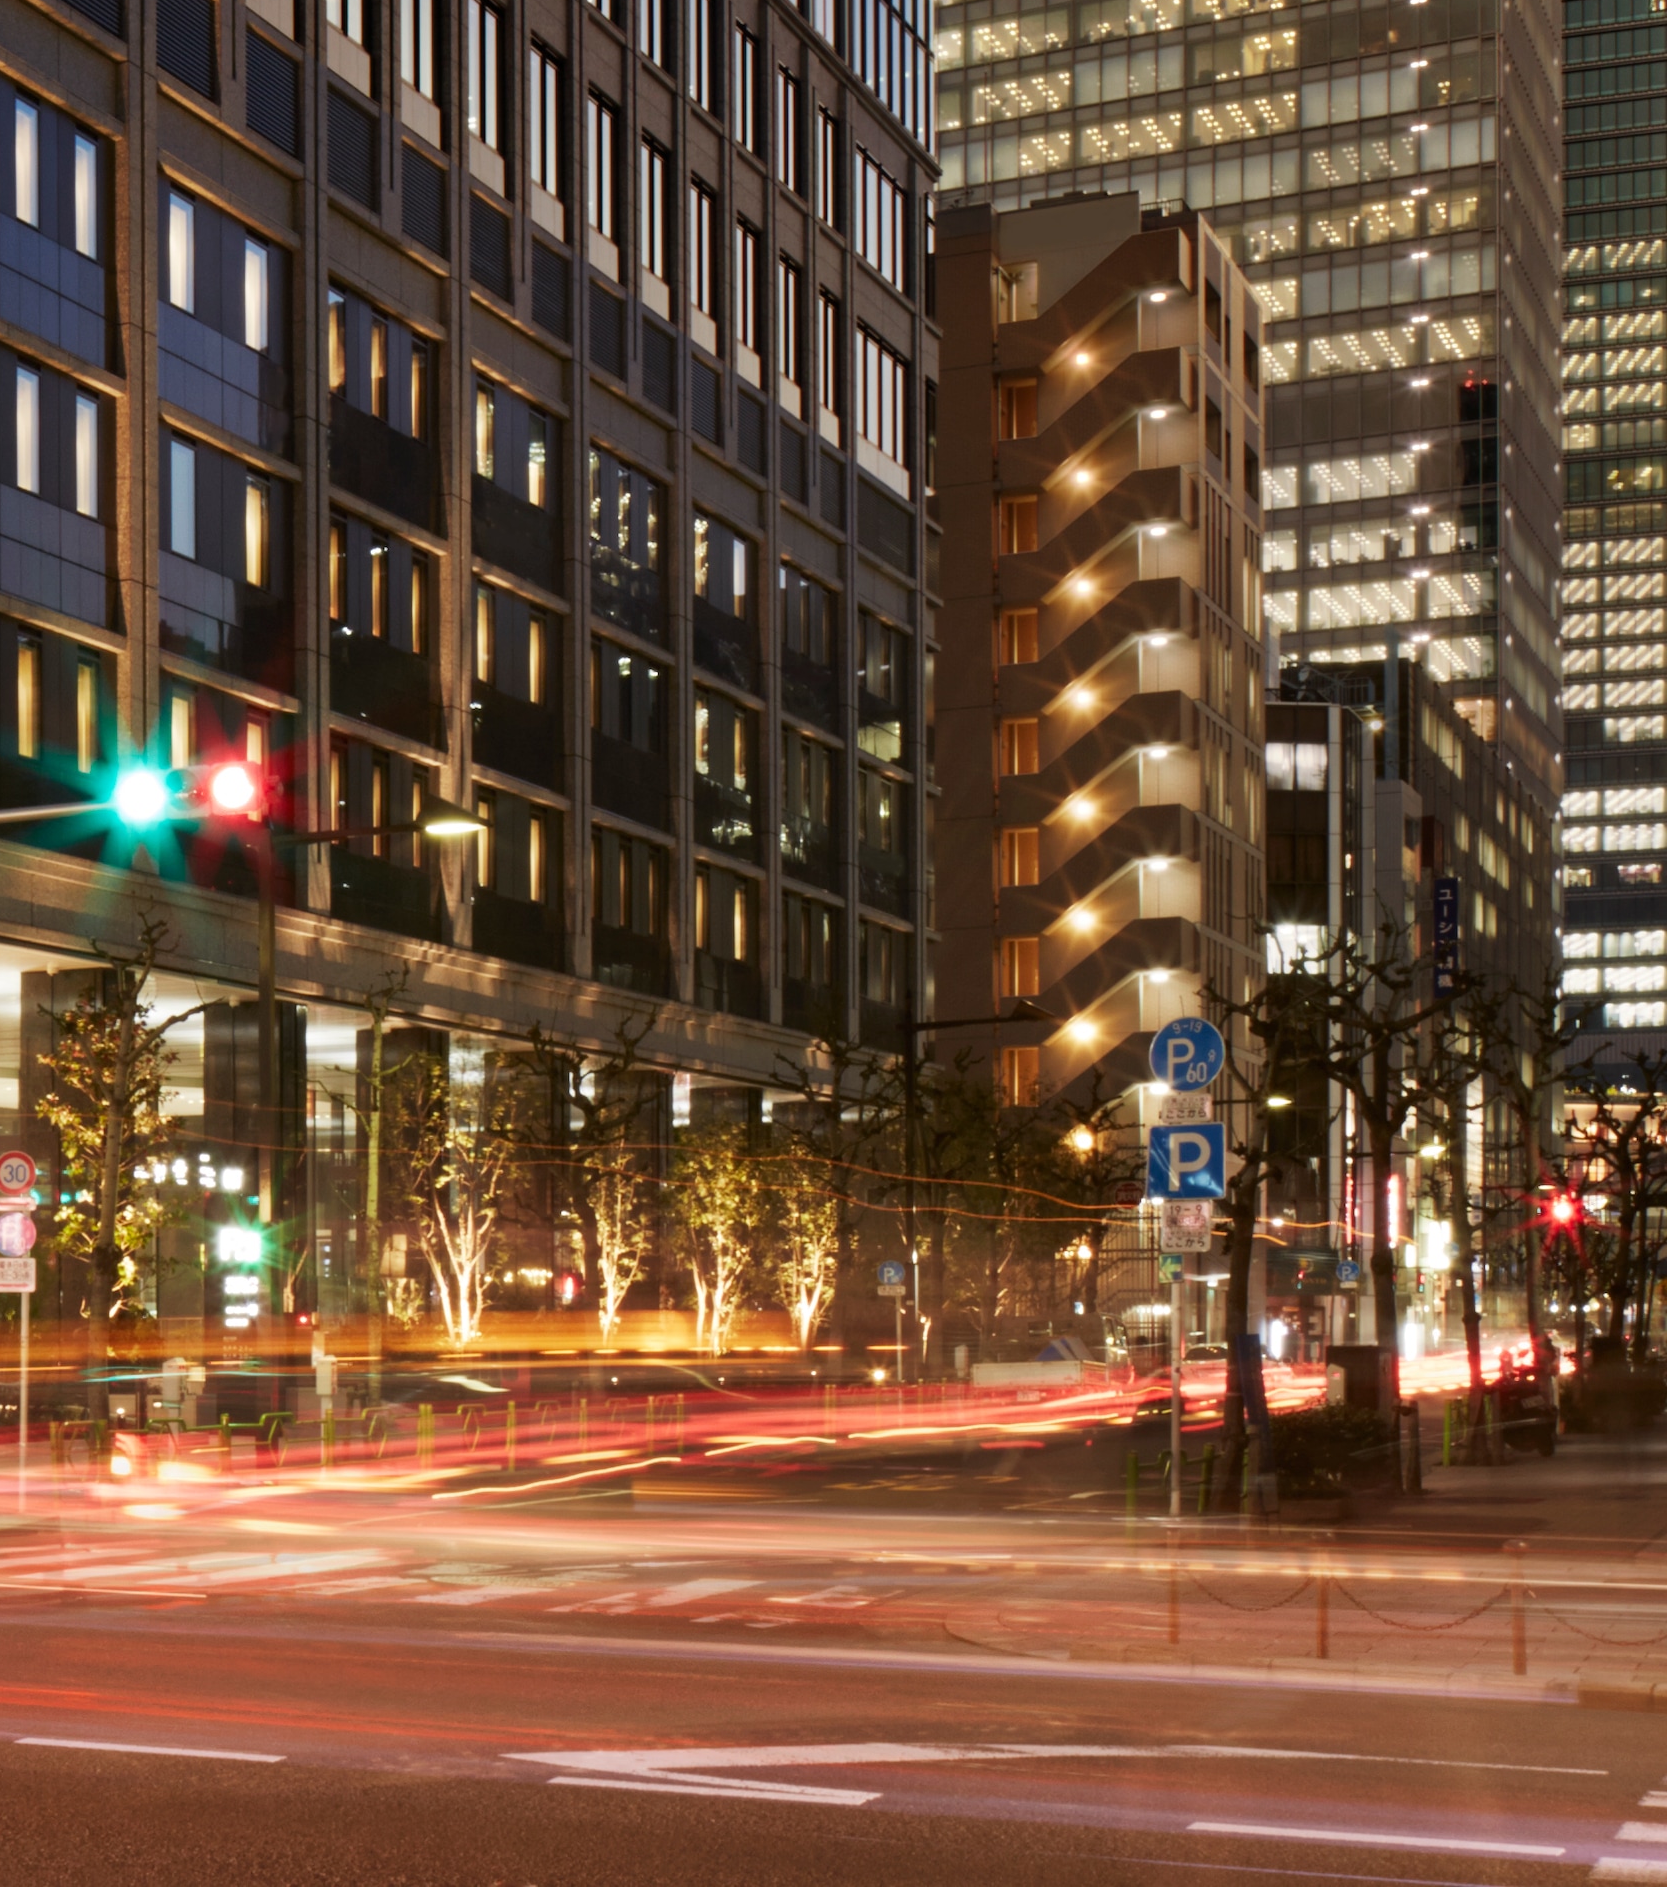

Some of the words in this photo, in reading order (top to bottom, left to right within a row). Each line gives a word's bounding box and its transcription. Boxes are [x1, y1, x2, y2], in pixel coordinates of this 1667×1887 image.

[1167, 1037, 1195, 1089] P
[1186, 1062, 1207, 1083] 60
[1166, 1109, 1206, 1119] ここから
[1169, 1132, 1211, 1192] P
[3, 1164, 27, 1183] 30
[1166, 1236, 1206, 1248] ここから
